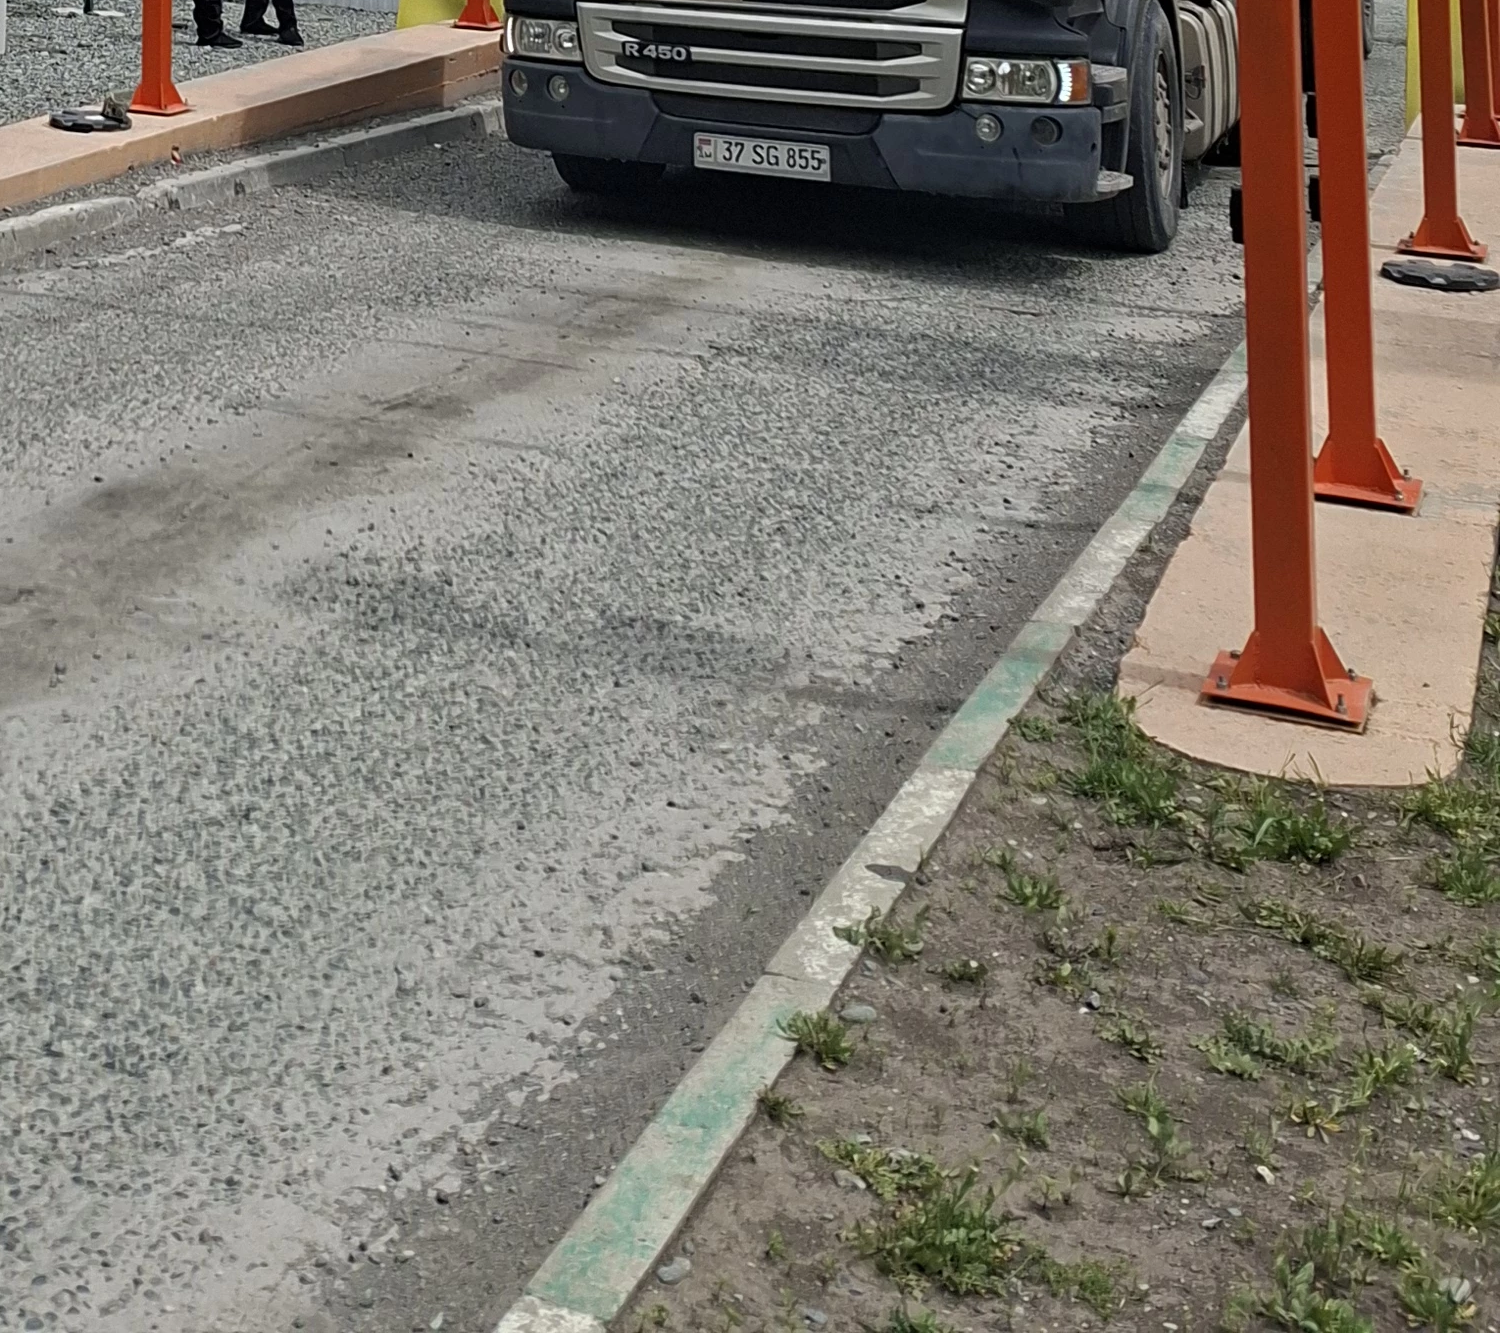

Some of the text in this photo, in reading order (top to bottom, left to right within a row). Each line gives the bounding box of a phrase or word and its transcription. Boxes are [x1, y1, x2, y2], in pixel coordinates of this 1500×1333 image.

[624, 42, 687, 61] R 450
[722, 140, 822, 171] 37 SG 855
